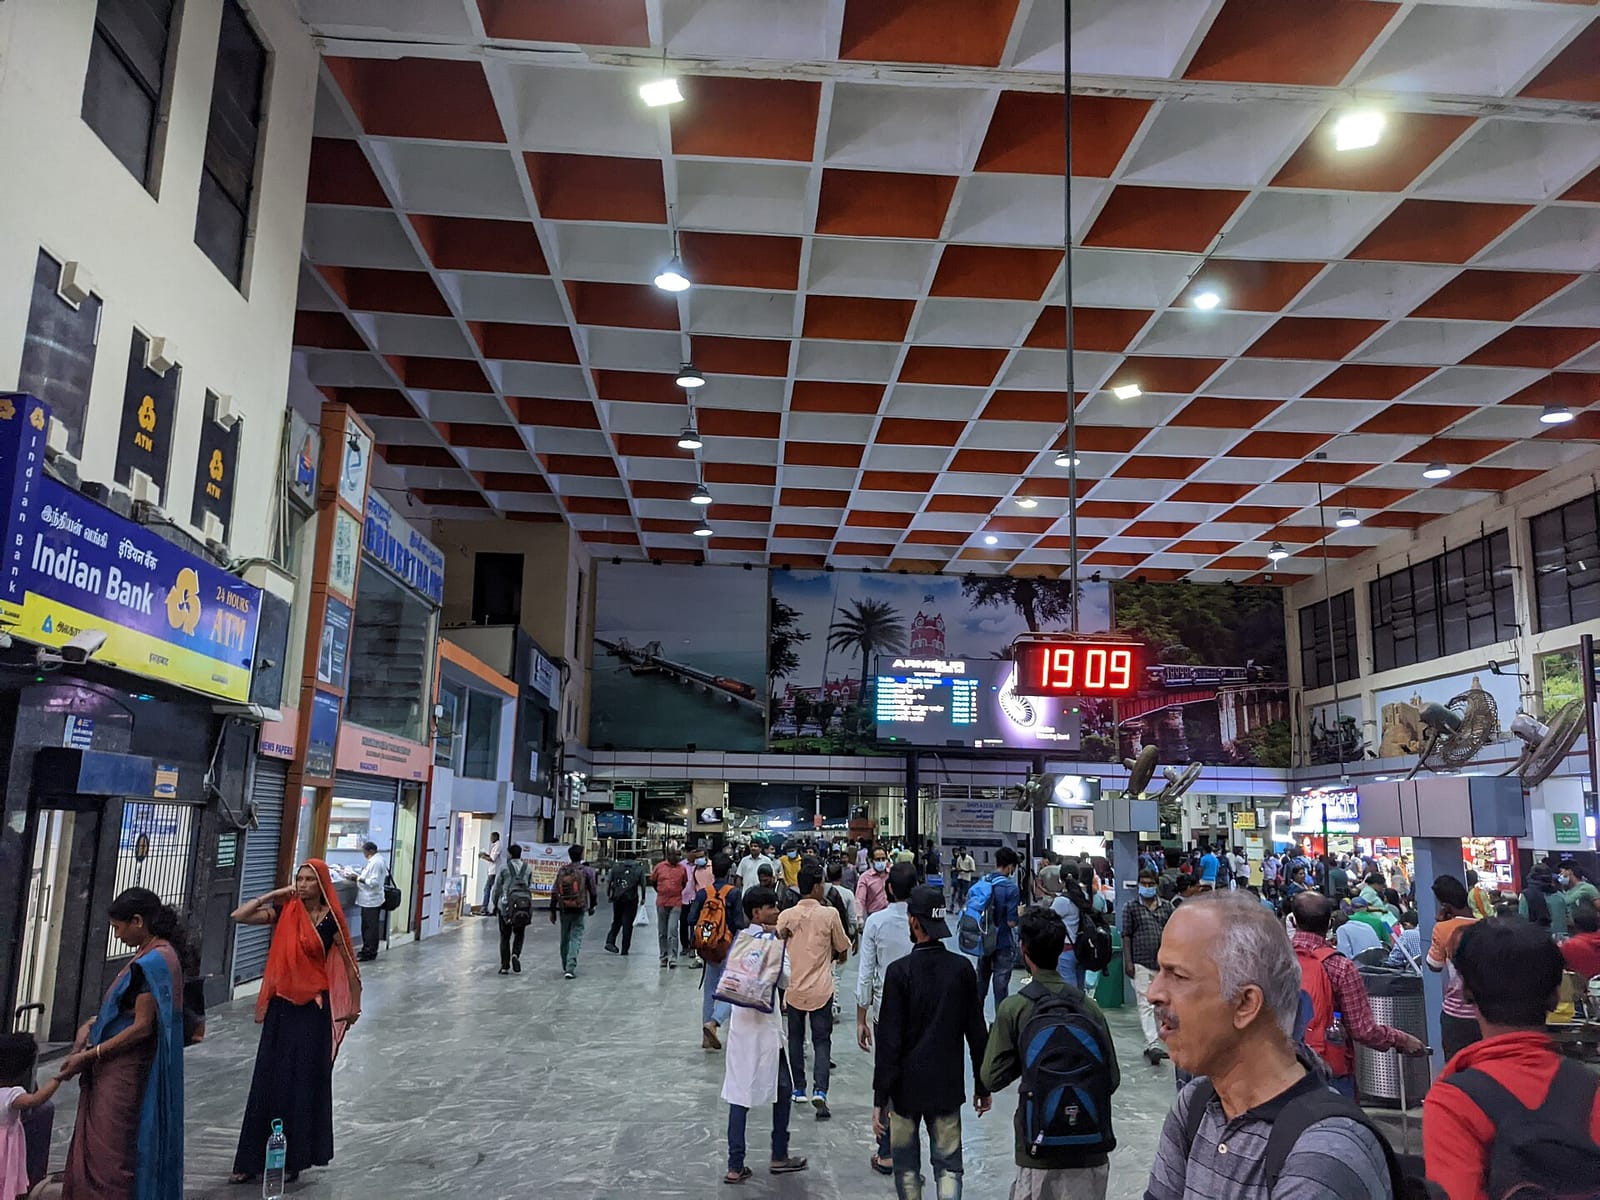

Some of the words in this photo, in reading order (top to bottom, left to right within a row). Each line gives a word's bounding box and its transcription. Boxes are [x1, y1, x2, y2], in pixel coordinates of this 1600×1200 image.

[134, 431, 153, 452] ATM
[18, 436, 37, 522] Indian
[206, 481, 221, 500] ATM
[9, 534, 23, 593] Bank
[31, 533, 102, 595] Indian
[105, 566, 155, 616] Bank
[215, 586, 225, 603] 24
[227, 590, 250, 613] HOURS
[210, 608, 247, 652] ATM
[1042, 648, 1074, 688] 19
[1085, 649, 1132, 689] 09
